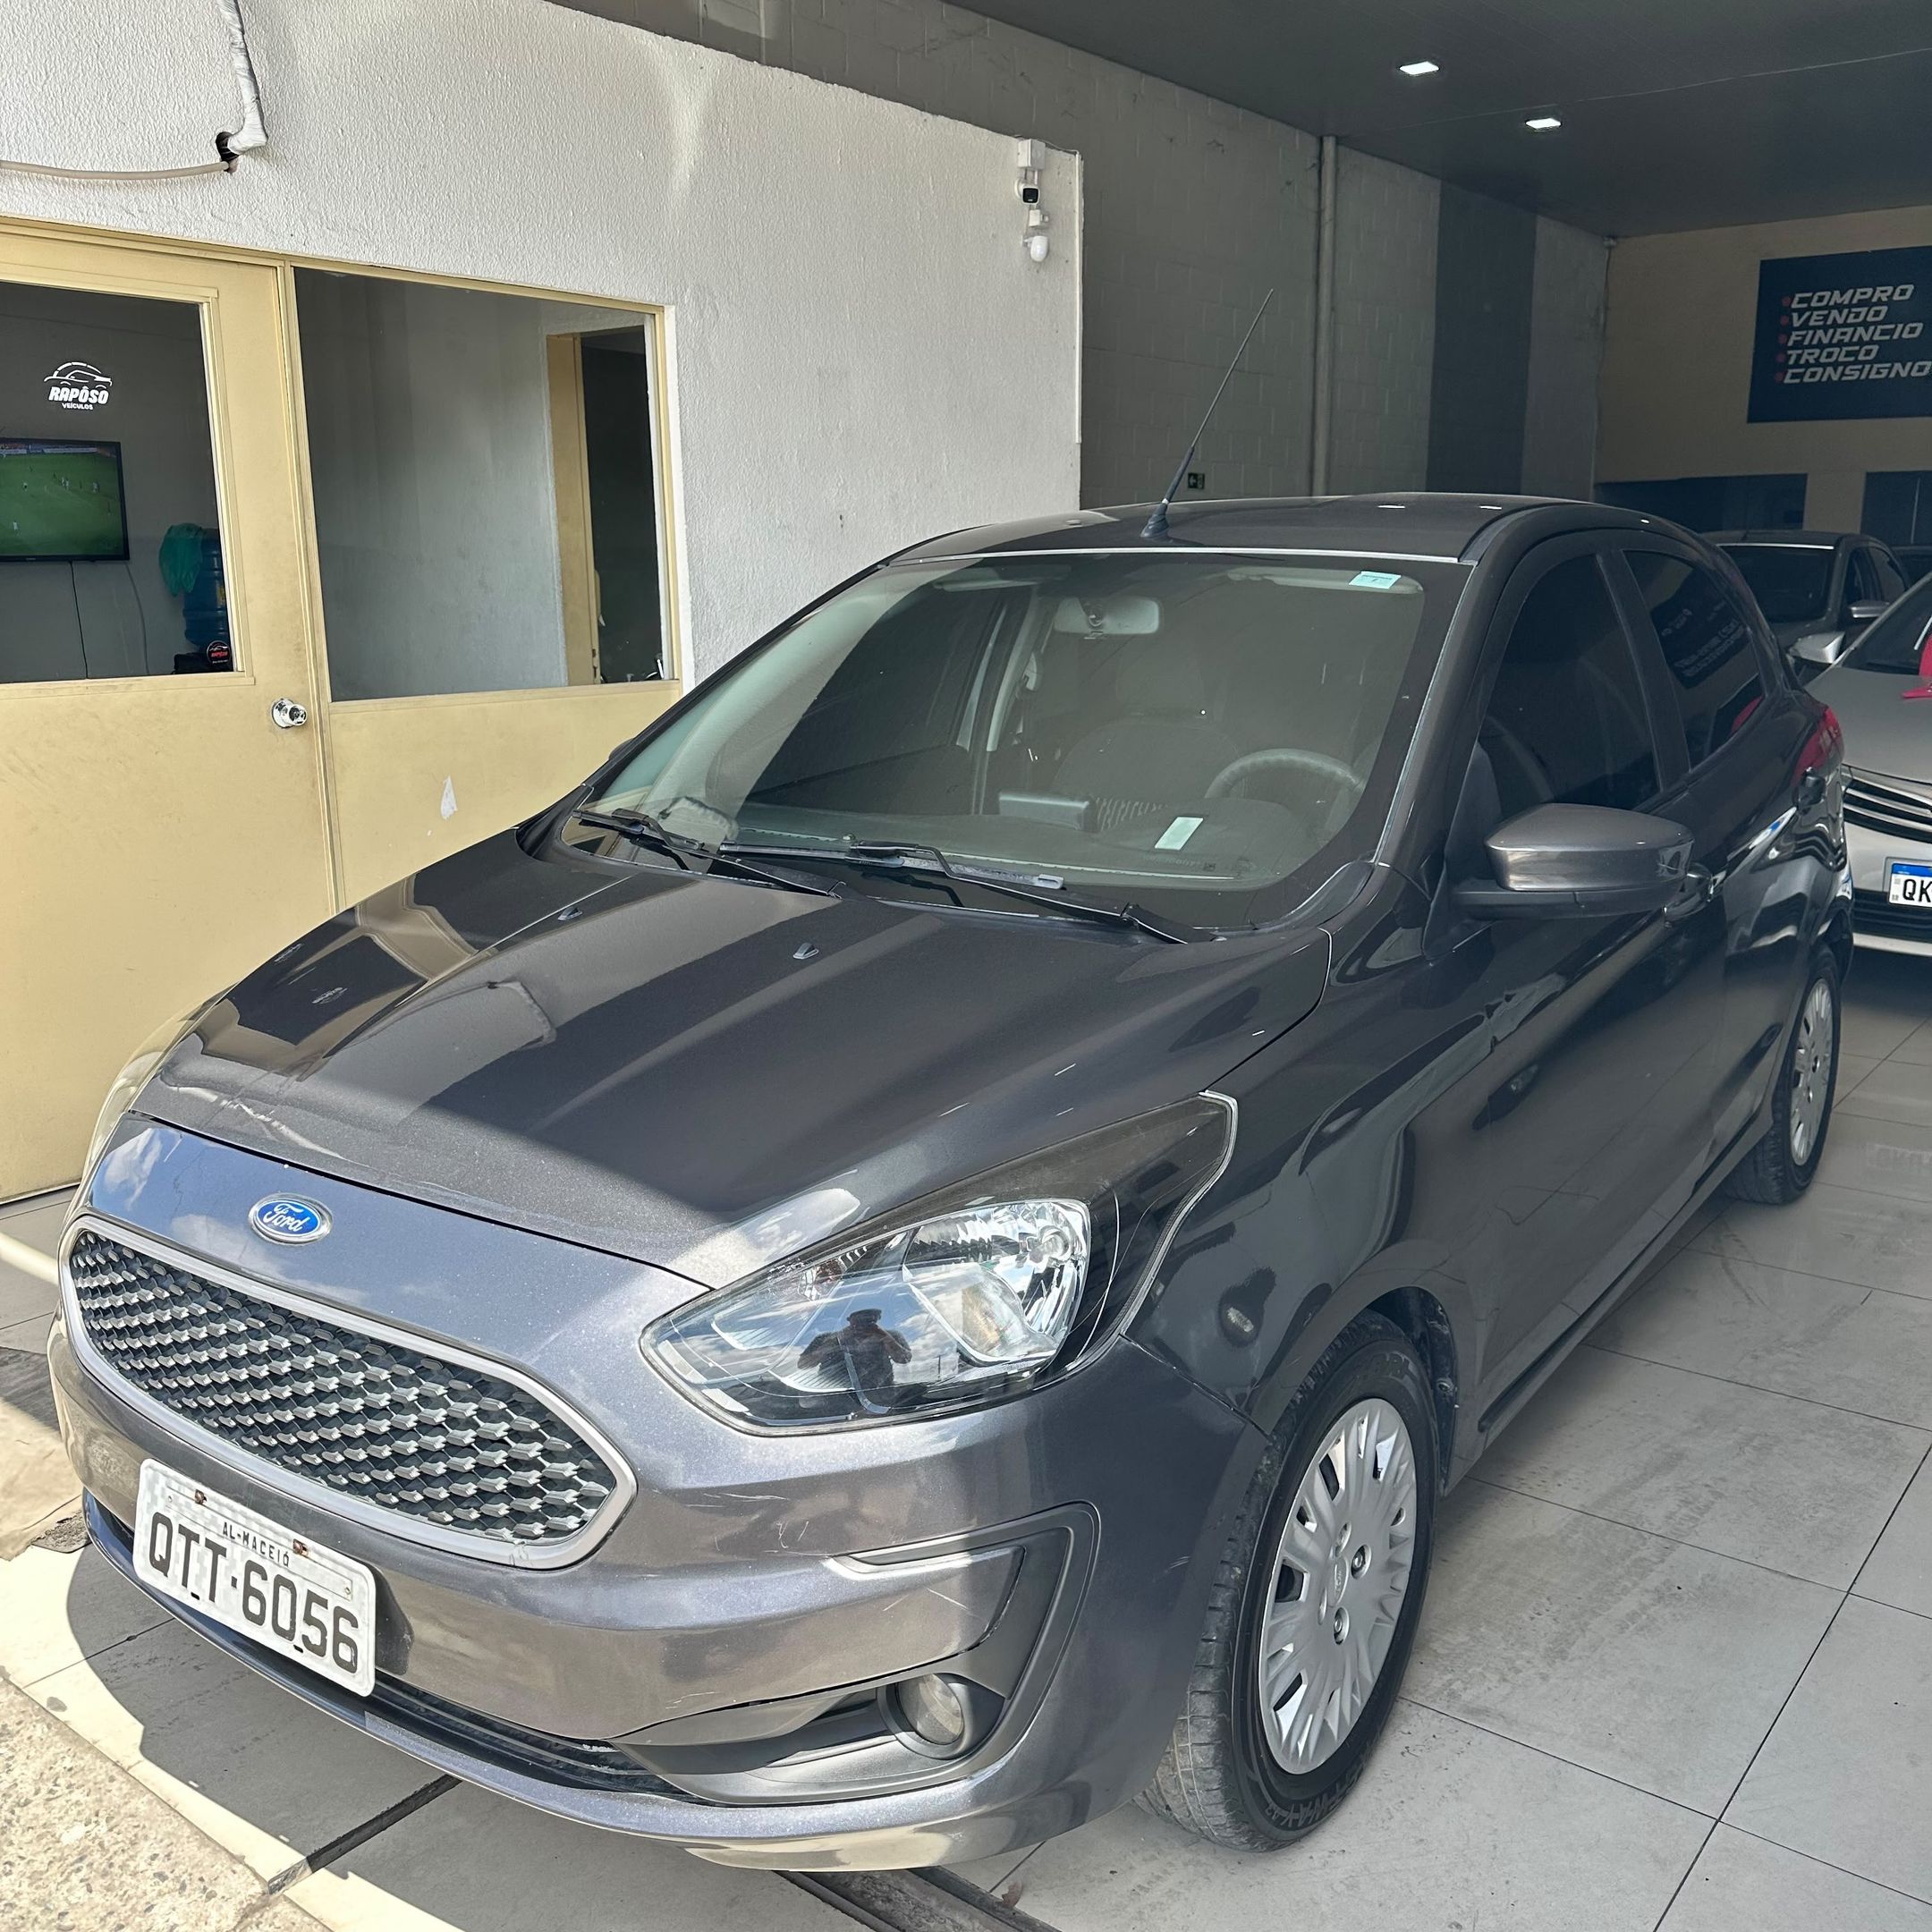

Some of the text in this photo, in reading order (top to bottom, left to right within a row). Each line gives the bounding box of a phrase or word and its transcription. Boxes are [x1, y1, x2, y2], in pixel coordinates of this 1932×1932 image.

[1791, 284, 1915, 309] COMPRO
[1791, 305, 1889, 327] VENDO
[1787, 322, 1924, 346] FINANCIO
[1786, 344, 1880, 365] TROCO
[1784, 360, 1932, 384] CONSIGNO
[48, 386, 109, 404] RAPÔSO
[262, 1203, 311, 1233] Ford
